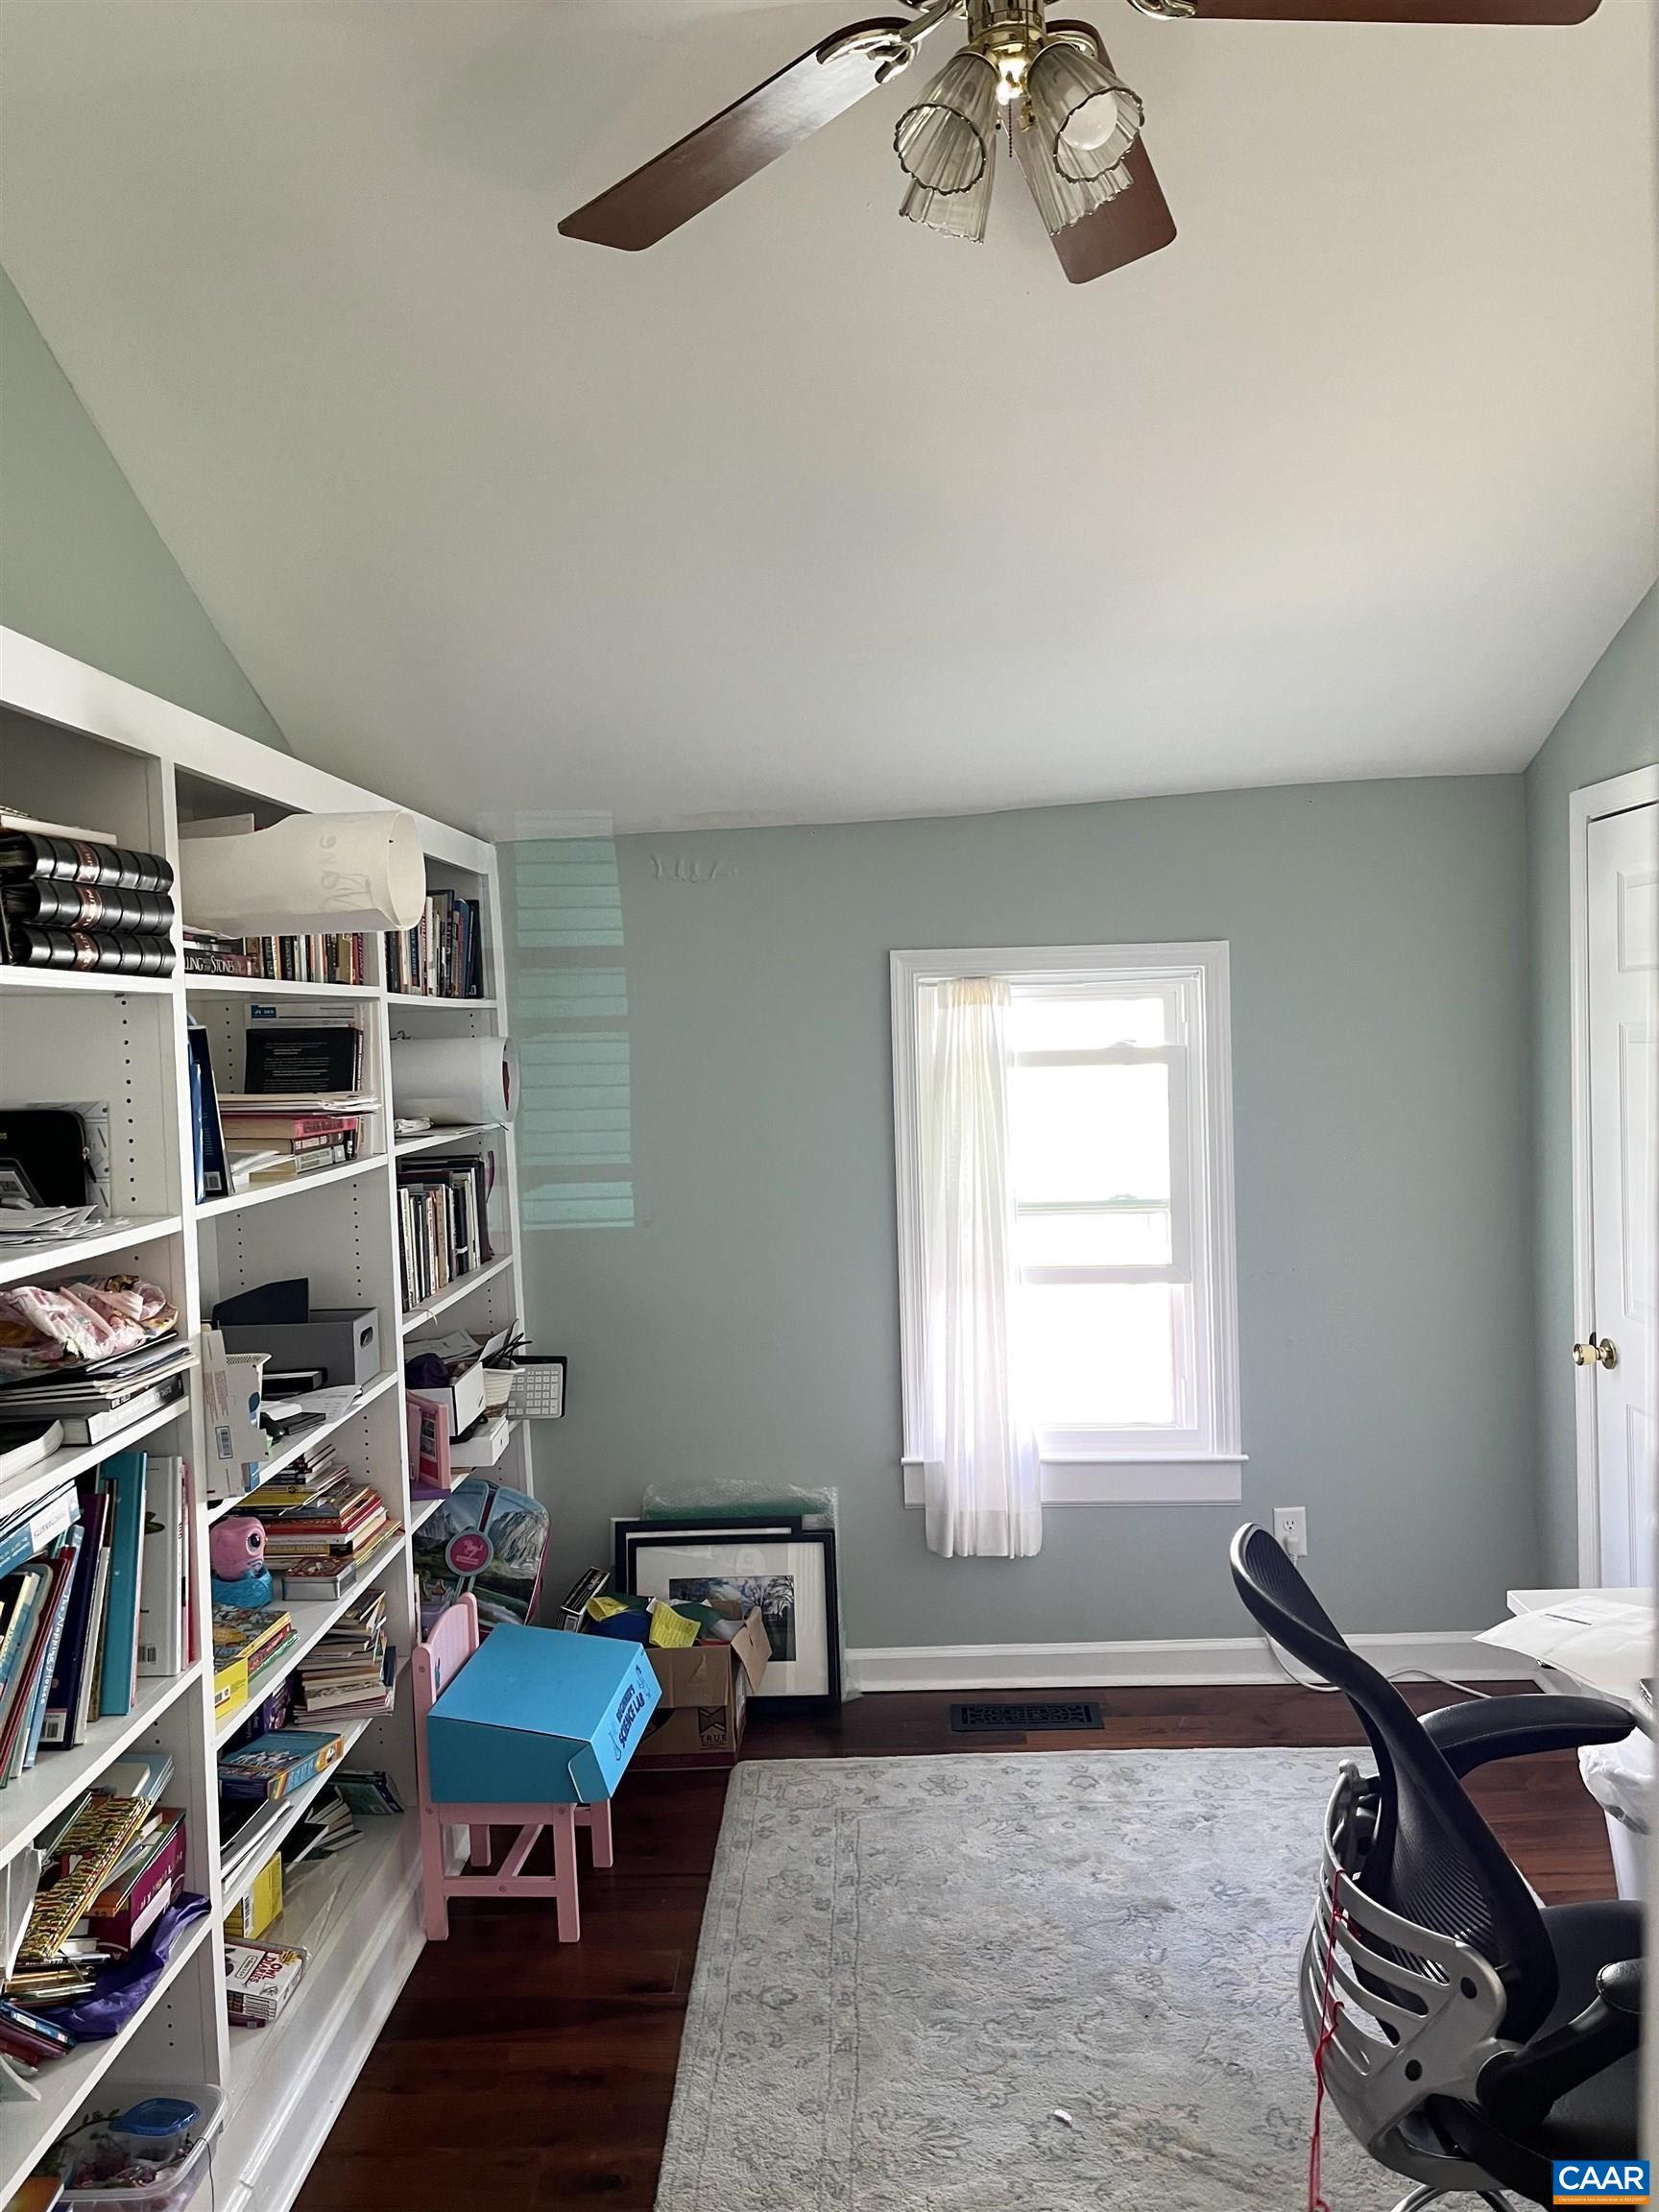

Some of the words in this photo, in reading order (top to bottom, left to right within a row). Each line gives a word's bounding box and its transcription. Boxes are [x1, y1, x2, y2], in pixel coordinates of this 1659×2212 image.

[60, 1594, 69, 1612] The
[47, 1612, 64, 1665] Napping
[40, 1666, 54, 1705] House
[619, 1705, 637, 1748] SCIENCE
[633, 1692, 645, 1714] LAB
[701, 1734, 728, 1743] TRUE
[250, 1955, 277, 1984] DIARIES
[262, 1962, 283, 1981] OWL
